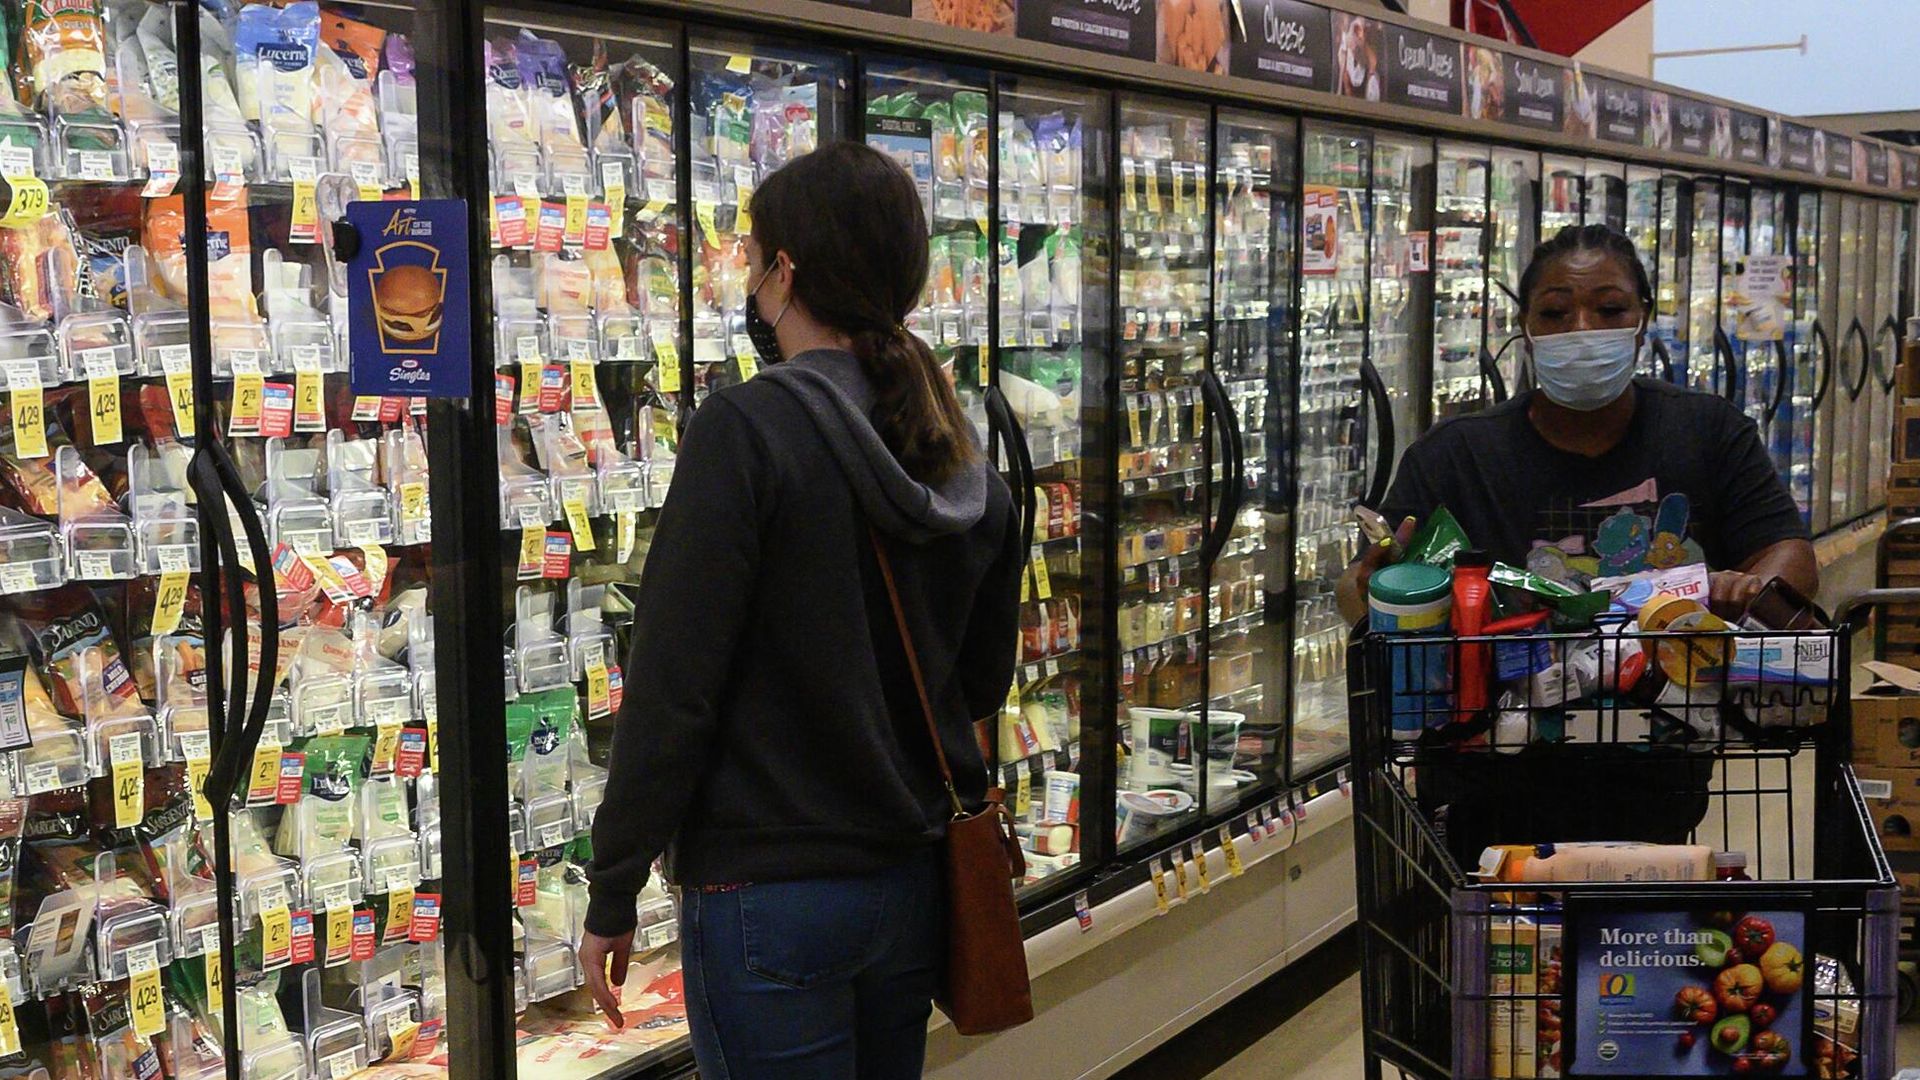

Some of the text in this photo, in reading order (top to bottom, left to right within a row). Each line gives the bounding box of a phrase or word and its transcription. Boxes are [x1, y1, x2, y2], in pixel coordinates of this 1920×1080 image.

[1264, 0, 1305, 54] Cheese
[259, 46, 307, 61] Lucerne
[1399, 35, 1454, 79] Cream Cheese
[382, 208, 413, 237] Art
[389, 367, 431, 384] Singles
[96, 393, 116, 423] 429
[178, 387, 193, 415] 42
[18, 405, 40, 435] 429
[161, 586, 183, 615] 429
[1600, 928, 1714, 945] More than
[1600, 950, 1706, 967] delicious.
[136, 984, 159, 1015] 429
